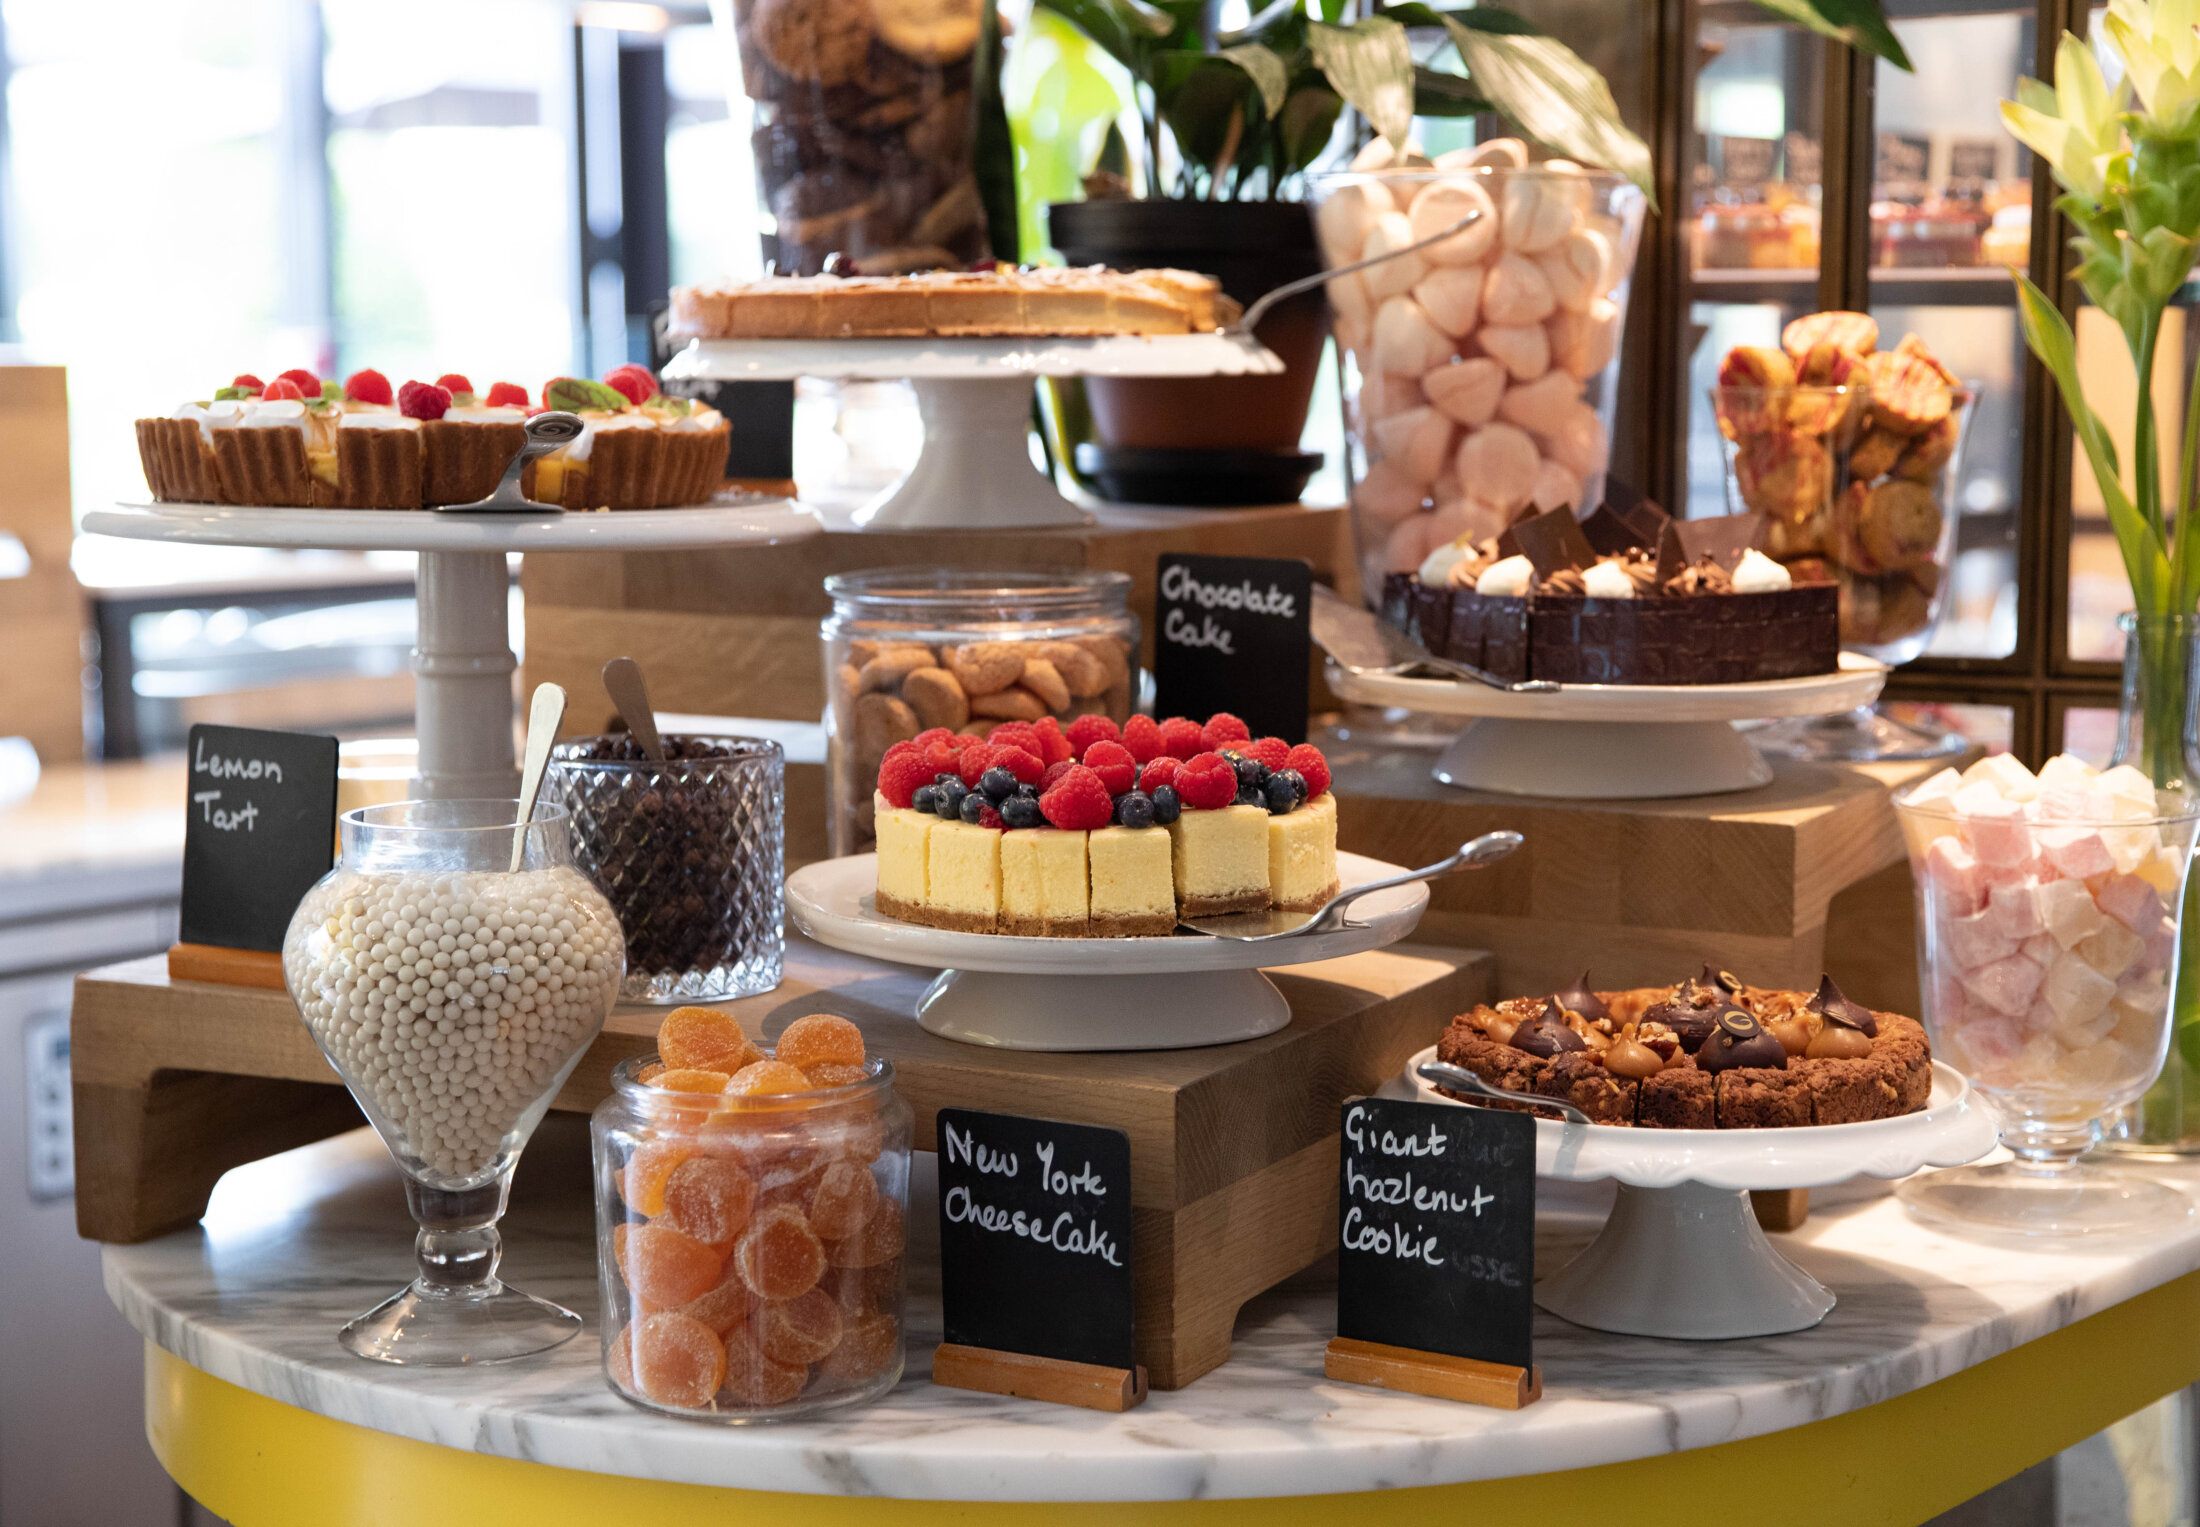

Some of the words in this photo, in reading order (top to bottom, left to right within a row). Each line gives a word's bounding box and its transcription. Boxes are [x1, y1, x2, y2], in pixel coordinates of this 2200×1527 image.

[1161, 564, 1296, 618] Chocolate
[1165, 608, 1235, 654] Cake
[195, 737, 282, 783] Lemon
[194, 790, 258, 832] Tart
[1346, 1106, 1447, 1156] Giant
[946, 1121, 1018, 1177] New
[1036, 1141, 1106, 1195] York
[1343, 1207, 1444, 1265] Cookie
